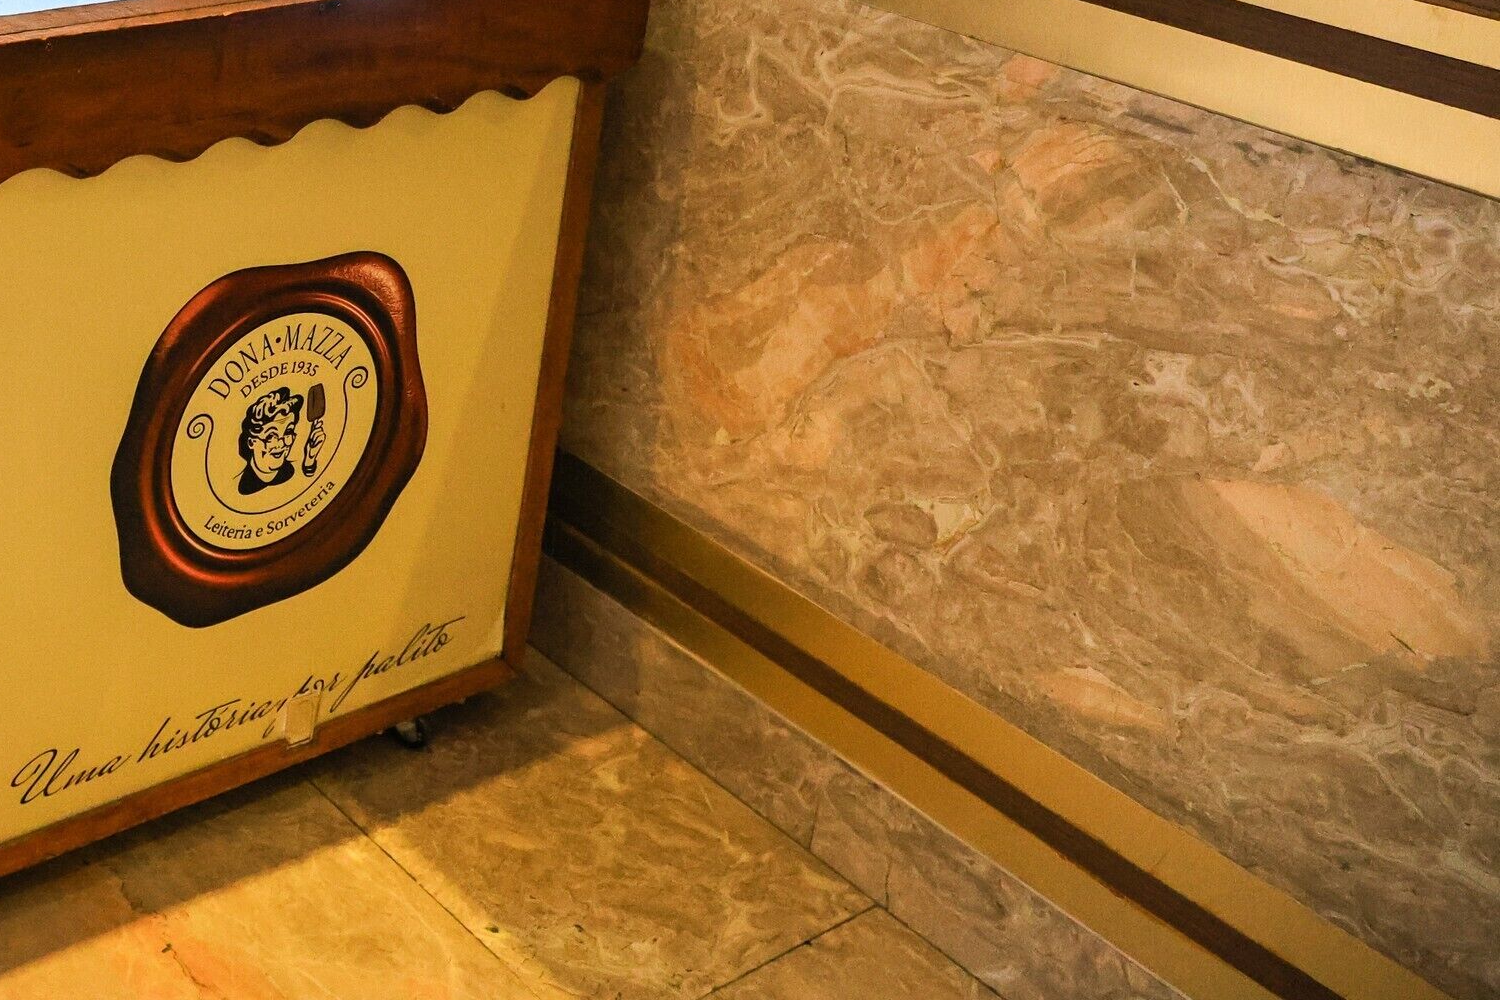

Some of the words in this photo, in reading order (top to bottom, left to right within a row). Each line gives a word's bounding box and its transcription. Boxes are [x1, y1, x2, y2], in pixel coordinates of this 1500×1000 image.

[207, 333, 275, 401] DONA
[281, 322, 353, 371] MAZZA
[239, 362, 289, 399] DESDE
[291, 360, 319, 377] 1935
[203, 515, 252, 539] Leiteria
[255, 526, 263, 537] e
[266, 480, 336, 535] Sorveteria
[10, 748, 132, 804] Uma
[330, 615, 467, 712] palito
